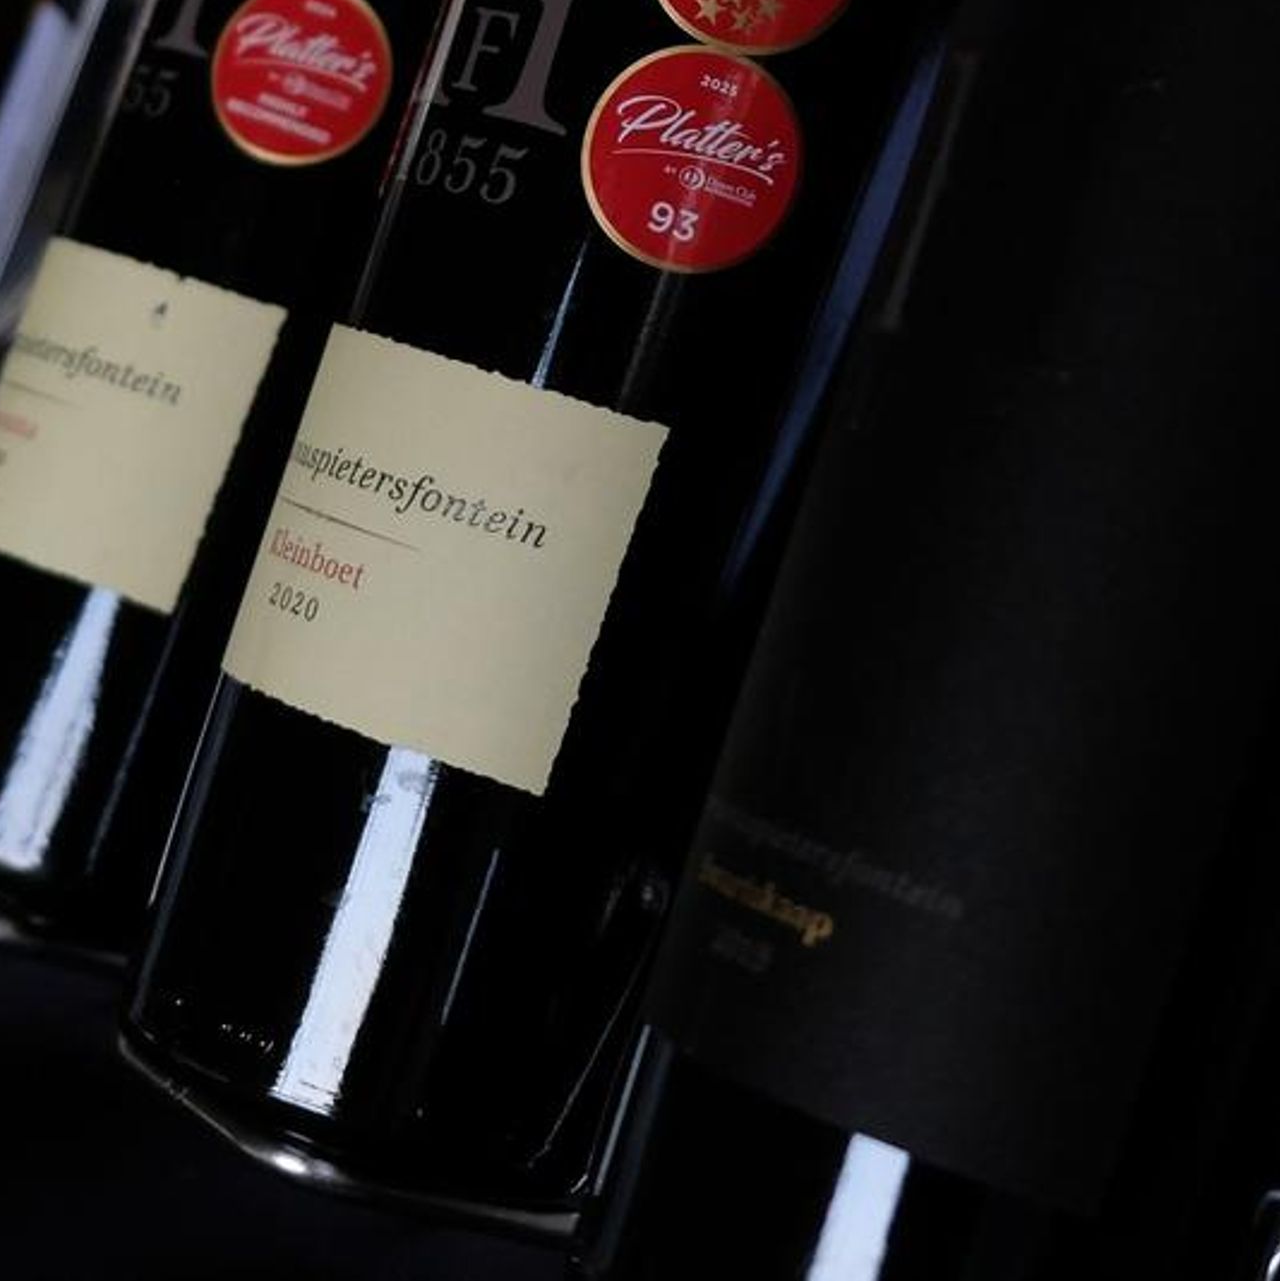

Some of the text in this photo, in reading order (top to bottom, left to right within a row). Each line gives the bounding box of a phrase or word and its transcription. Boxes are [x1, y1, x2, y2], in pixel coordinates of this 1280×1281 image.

[450, 5, 522, 93] F
[699, 73, 739, 97] 2025
[616, 94, 786, 172] Platter's
[647, 201, 700, 242] 93
[268, 582, 319, 623] 2020
